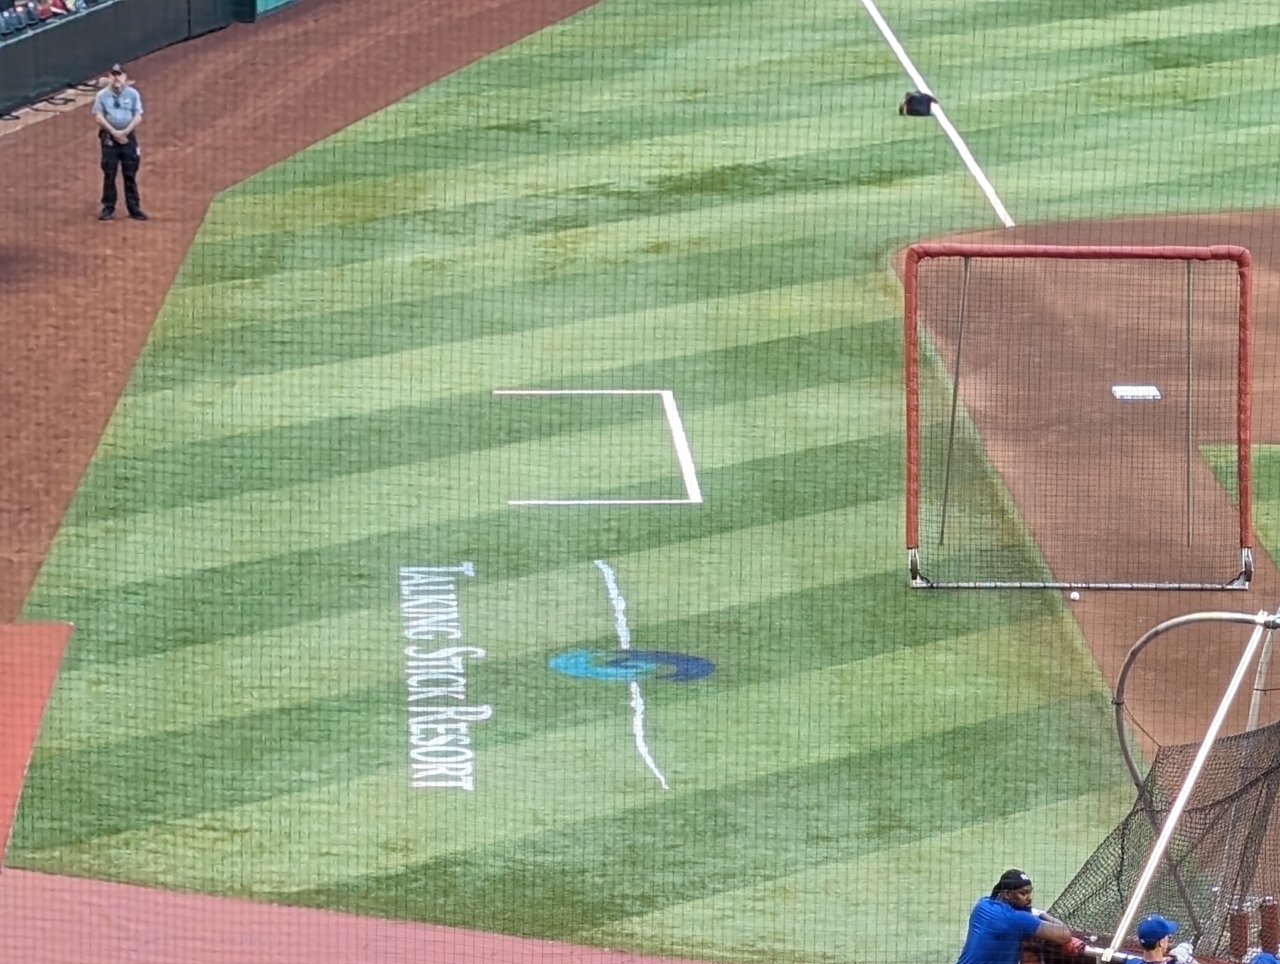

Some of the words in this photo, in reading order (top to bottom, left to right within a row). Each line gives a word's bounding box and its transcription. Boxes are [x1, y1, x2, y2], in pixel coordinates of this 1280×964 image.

[399, 561, 475, 640] TALKING
[404, 645, 486, 701] STICK
[408, 704, 493, 791] RESORT
